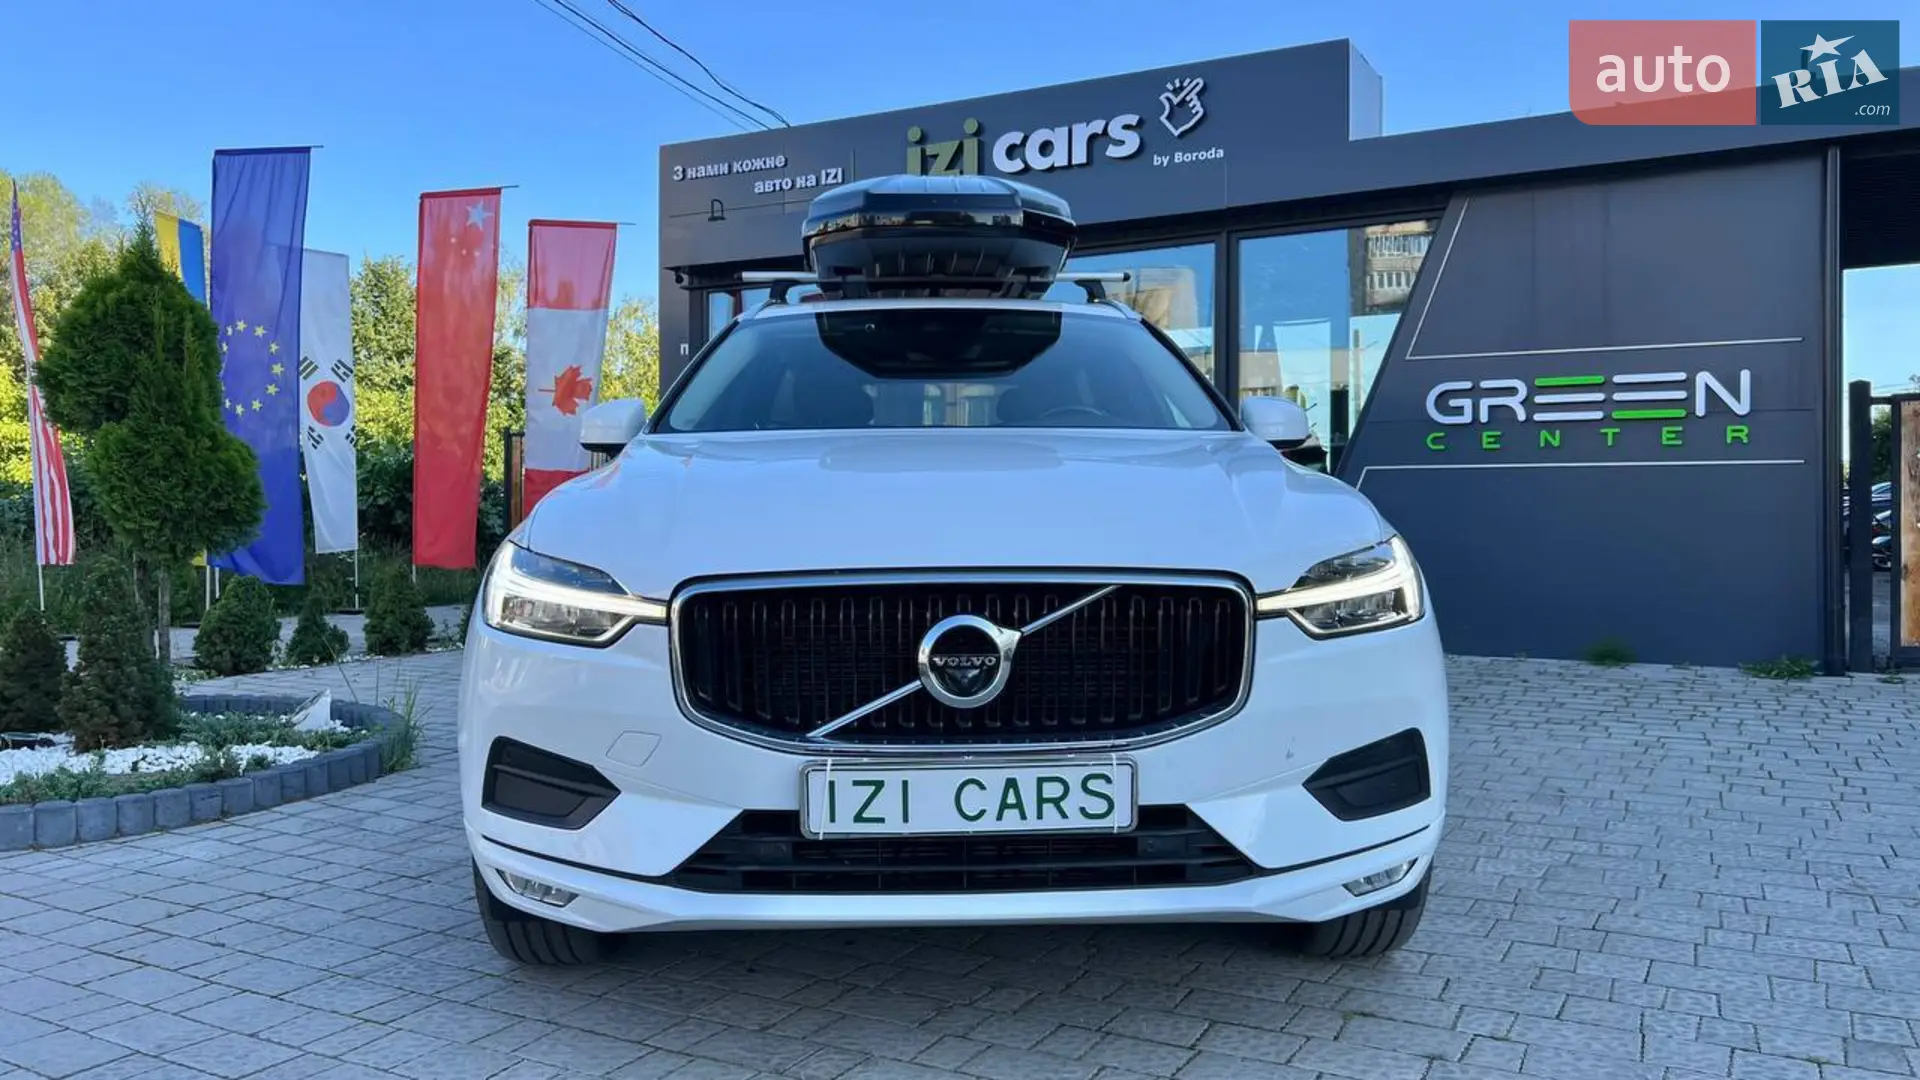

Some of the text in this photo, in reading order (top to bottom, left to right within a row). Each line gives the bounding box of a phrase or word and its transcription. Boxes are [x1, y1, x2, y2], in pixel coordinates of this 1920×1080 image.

[907, 114, 1141, 176] izi cars
[1153, 147, 1225, 167] by Boroda
[687, 162, 729, 179] нами
[733, 155, 786, 173] кожне
[754, 167, 843, 194] авто на IZI
[1426, 369, 1751, 424] GREEN
[1426, 425, 1749, 450] CENTER
[932, 656, 997, 668] VOLVO
[828, 773, 1116, 824] IZI CARS
